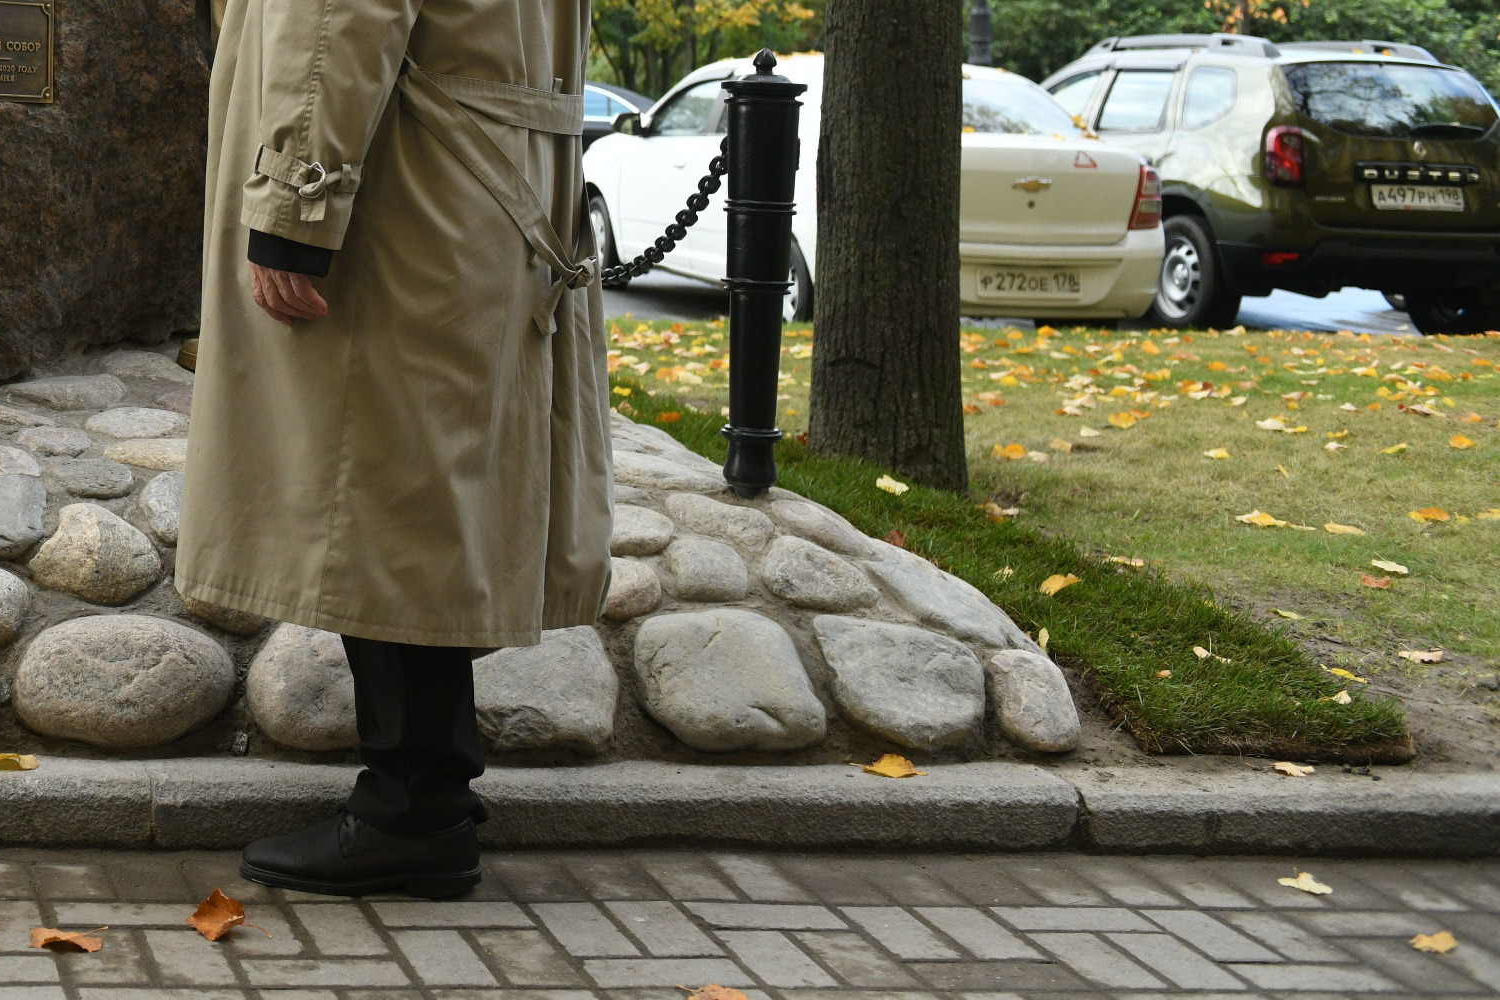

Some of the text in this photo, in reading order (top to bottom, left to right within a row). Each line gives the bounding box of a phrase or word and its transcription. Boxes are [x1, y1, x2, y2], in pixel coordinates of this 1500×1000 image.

[6, 41, 41, 52] СОБОР
[17, 65, 39, 74] ГОДУ
[1363, 168, 1479, 181] DUSTER
